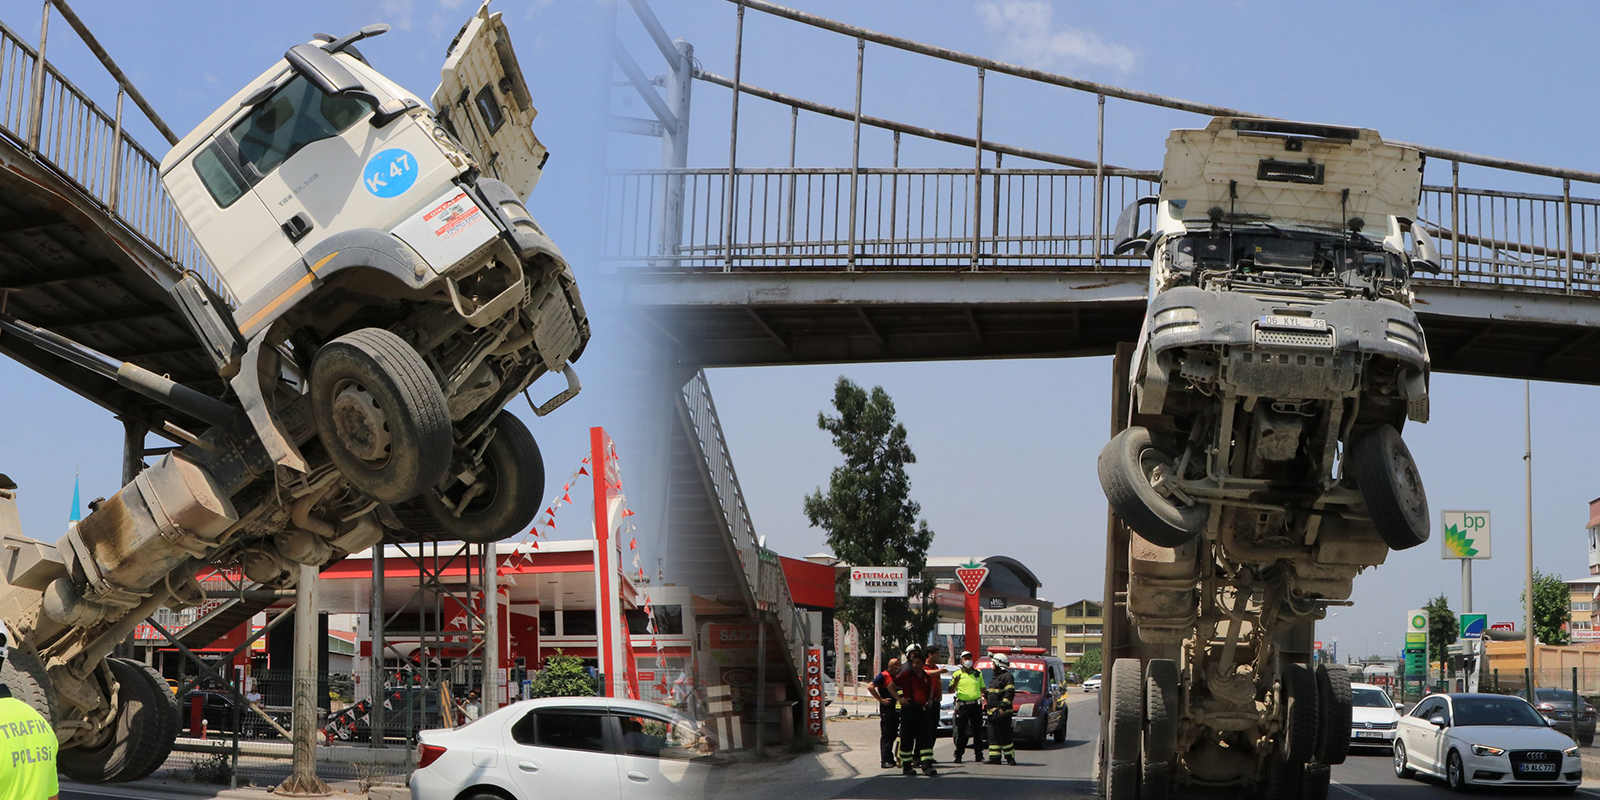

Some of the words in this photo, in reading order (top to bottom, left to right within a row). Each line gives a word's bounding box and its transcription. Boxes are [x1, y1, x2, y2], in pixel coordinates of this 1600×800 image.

[389, 153, 410, 178] 47
[1266, 316, 1278, 325] 06
[1283, 317, 1301, 326] KYL
[1313, 319, 1324, 328] 29
[1463, 512, 1486, 532] bp
[983, 614, 1036, 624] SAFRANBOLU
[983, 624, 1036, 634] LOKUMCUSU
[807, 654, 821, 733] KOKOREÇ
